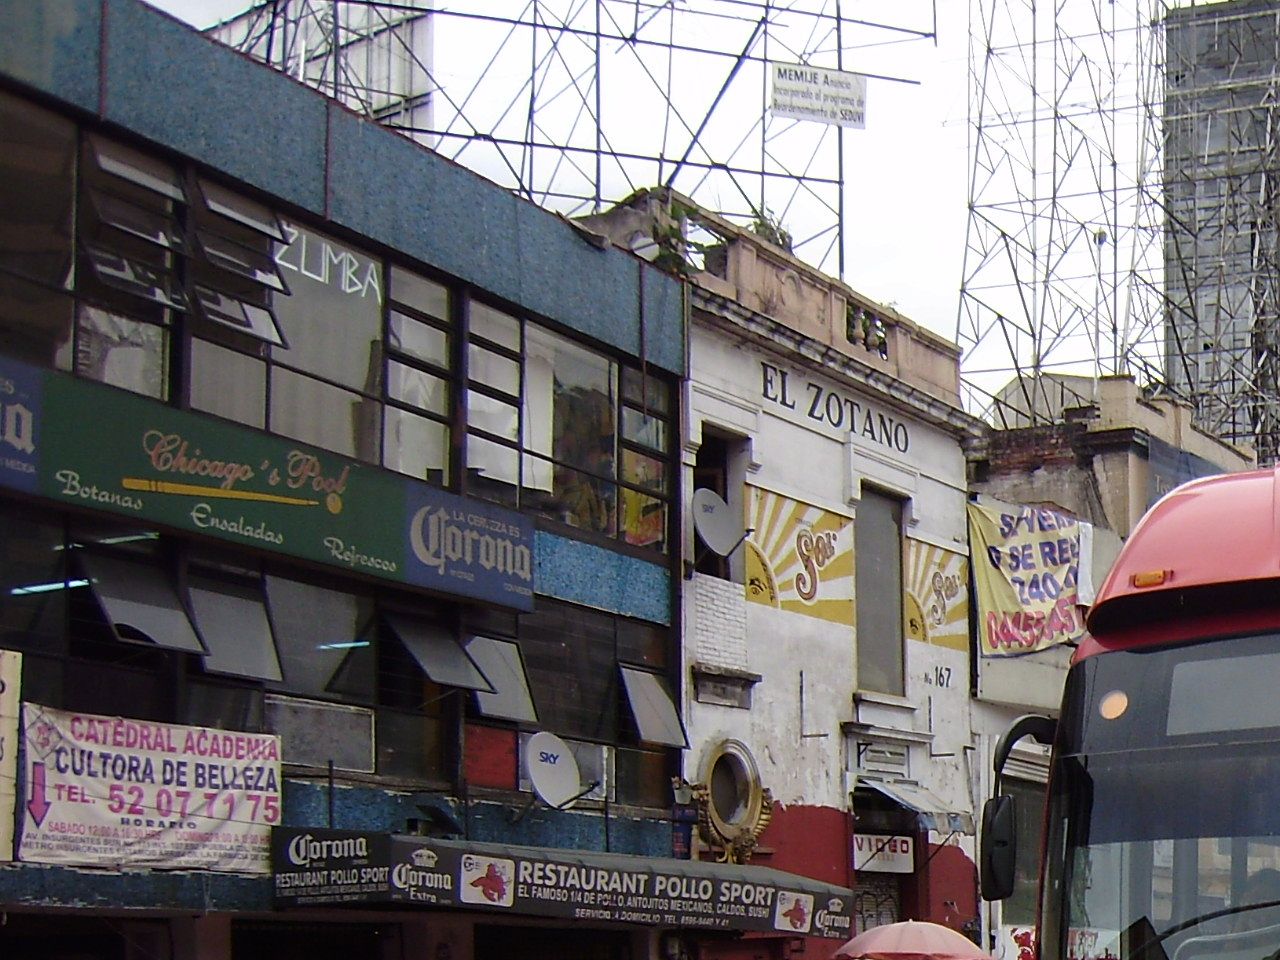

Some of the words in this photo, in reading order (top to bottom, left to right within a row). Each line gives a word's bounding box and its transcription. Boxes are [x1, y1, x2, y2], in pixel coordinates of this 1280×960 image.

[777, 67, 818, 84] MEMIJE
[275, 221, 381, 305] ZUMBA
[761, 362, 795, 409] EL
[807, 383, 908, 453] ZOTANO
[143, 430, 281, 489] Chicago's
[287, 450, 349, 493] Pool
[55, 470, 143, 510] Botanas
[191, 503, 283, 545] Ensaladas
[323, 537, 396, 573] Refrescos
[410, 505, 531, 581] Corona
[1008, 543, 1036, 573] SE
[935, 666, 951, 688] 167
[55, 747, 155, 784] CULTORA
[163, 760, 187, 787] DE
[195, 763, 278, 793] BELLEZA
[539, 752, 559, 765] SKY
[55, 783, 96, 804] TEL.
[108, 783, 145, 815] 52
[156, 788, 190, 818] 07
[204, 792, 235, 820] 71
[247, 795, 280, 823] 75
[288, 834, 368, 867] Corona
[855, 836, 909, 854] VIDEO
[276, 871, 328, 888] RESTAURANT
[331, 868, 358, 885] POLLO
[361, 867, 389, 883] SPORT
[392, 863, 452, 891] Corona
[518, 861, 648, 894] RESTAURANT
[655, 875, 713, 900] POLLO
[720, 882, 776, 906] SPORT
[410, 889, 437, 903] Extra
[518, 884, 529, 897] EL
[531, 886, 569, 902] FAMOSO
[583, 892, 595, 904] DE
[626, 896, 669, 910] ANTOJITOS
[575, 908, 611, 919] SERVICIO
[815, 909, 850, 930] Corona
